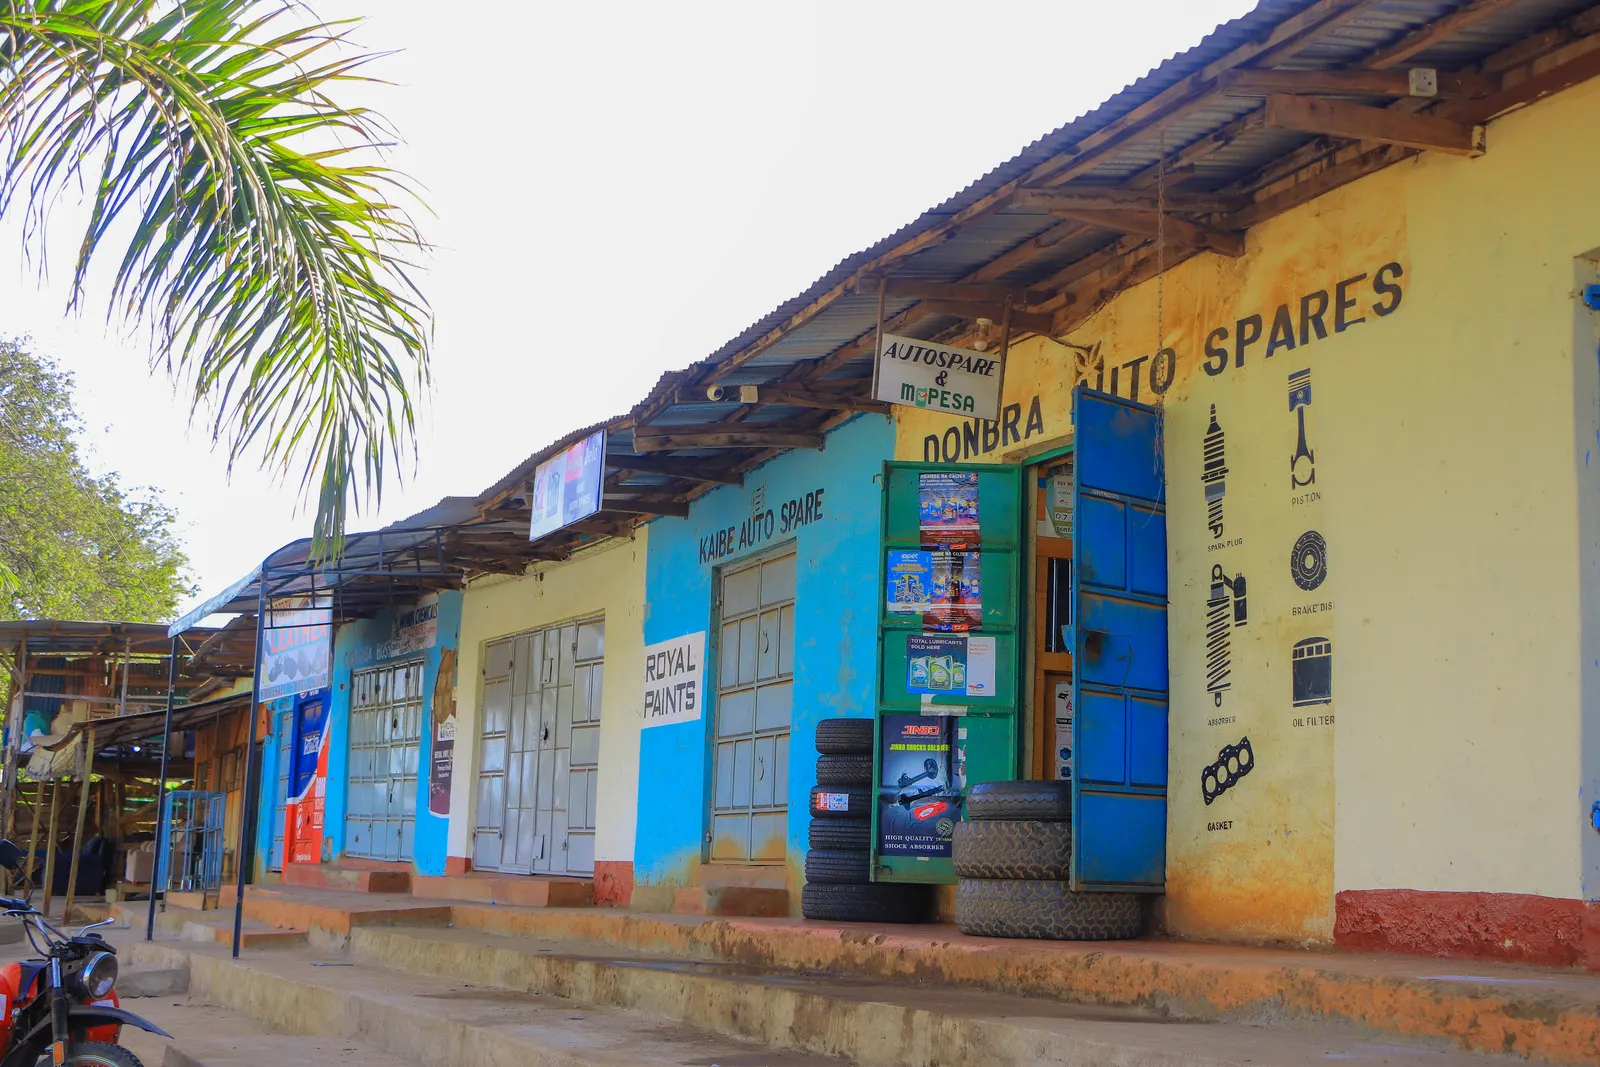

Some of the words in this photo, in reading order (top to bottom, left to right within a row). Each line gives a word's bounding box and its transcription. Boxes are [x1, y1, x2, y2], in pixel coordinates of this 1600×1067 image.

[883, 342, 1000, 377] AUTOSPARE
[924, 395, 1044, 463] DONBRA
[1078, 347, 1176, 402] UTO
[1203, 261, 1404, 377] SPARES
[935, 370, 948, 387] &
[1291, 492, 1321, 507] PISTON
[699, 526, 735, 564] KAIBE
[738, 509, 774, 551] AUTO
[780, 488, 825, 534] SPARE
[1208, 542, 1226, 552] SPARK
[1226, 538, 1243, 548] PLUG
[1292, 604, 1318, 616] BRAKE
[271, 612, 329, 654] LEATHER
[645, 644, 696, 683] ROYAL
[643, 680, 696, 719] PAINTS
[1208, 716, 1236, 727] ABSORBER
[1292, 718, 1304, 728] OIL
[1307, 716, 1335, 727] FILTER
[900, 725, 940, 735] JINBO
[1207, 821, 1233, 832] GASKET
